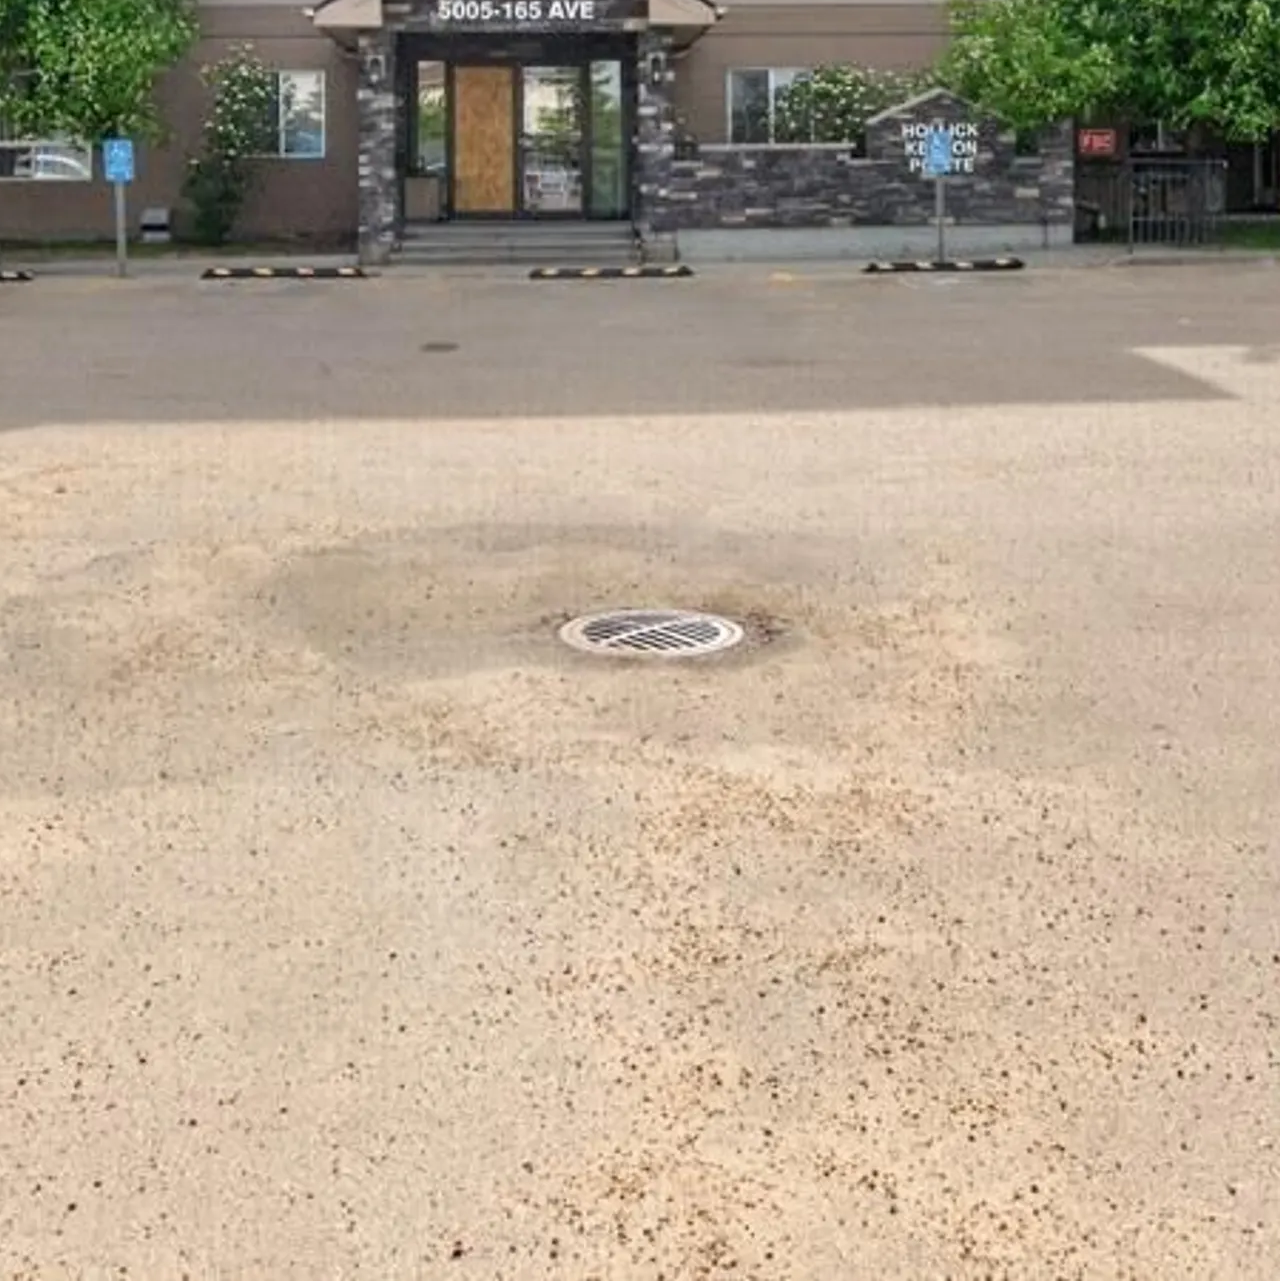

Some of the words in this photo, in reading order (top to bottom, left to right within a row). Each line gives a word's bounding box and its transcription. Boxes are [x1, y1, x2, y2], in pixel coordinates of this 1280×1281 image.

[438, 0, 542, 20] 5005-165
[548, 0, 595, 20] AVE
[904, 140, 977, 156] KEON
